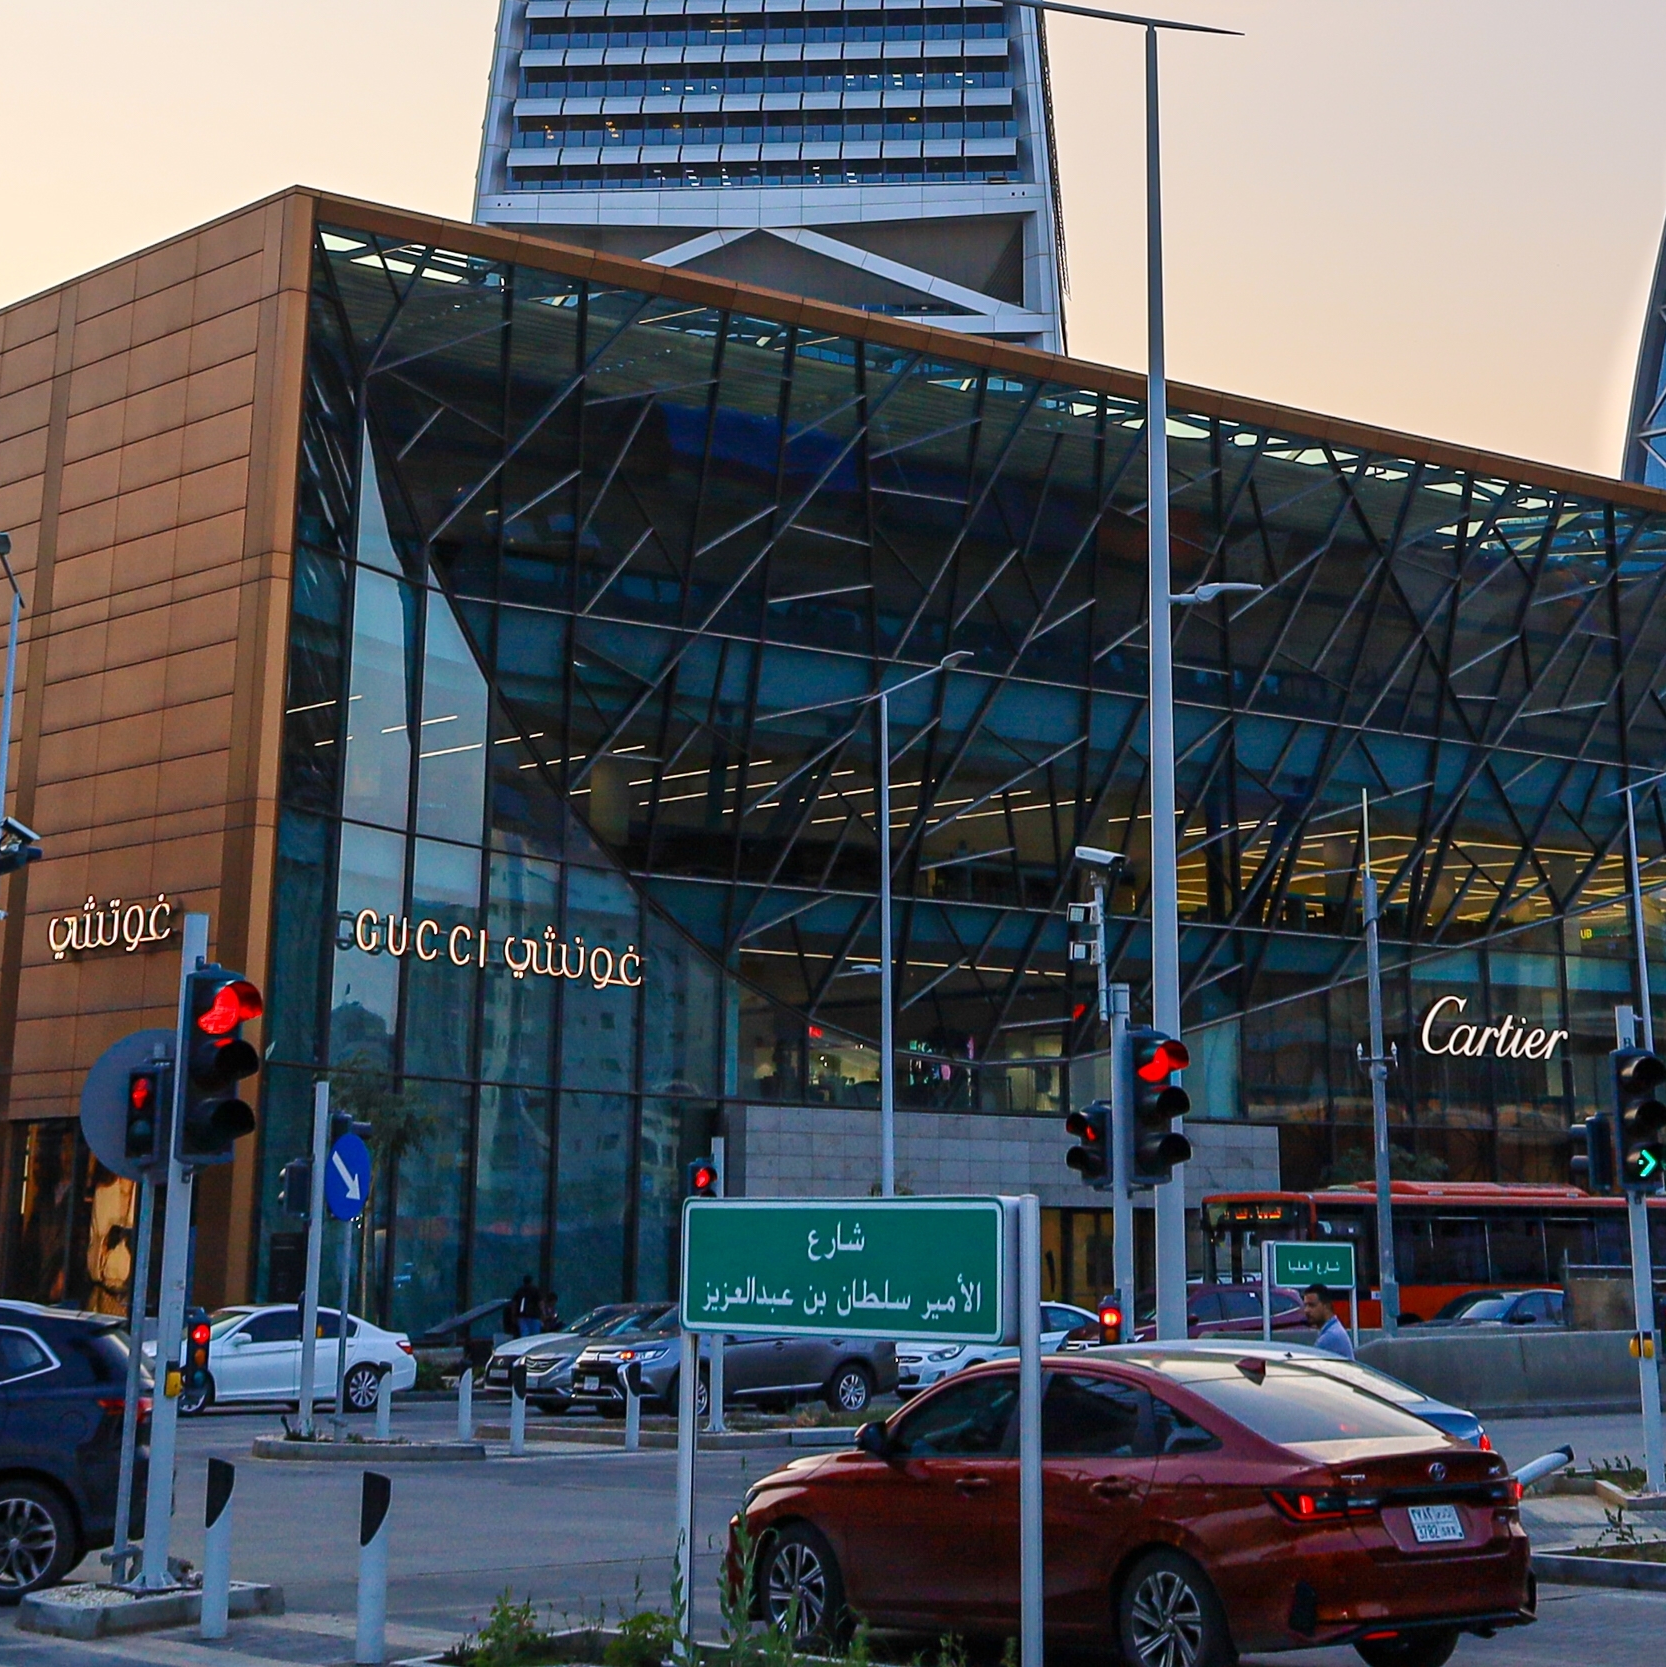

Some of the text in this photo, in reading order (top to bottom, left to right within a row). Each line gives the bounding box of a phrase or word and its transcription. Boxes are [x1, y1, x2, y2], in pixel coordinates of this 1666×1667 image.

[48, 893, 172, 961] غوتشي
[355, 908, 488, 968] GUCCI
[1421, 995, 1569, 1060] Cartier
[807, 1220, 865, 1261] شارع
[1316, 1260, 1340, 1275] شارع
[803, 1284, 827, 1316] بن
[836, 1278, 911, 1316] سلطان
[920, 1273, 981, 1320] الأمير
